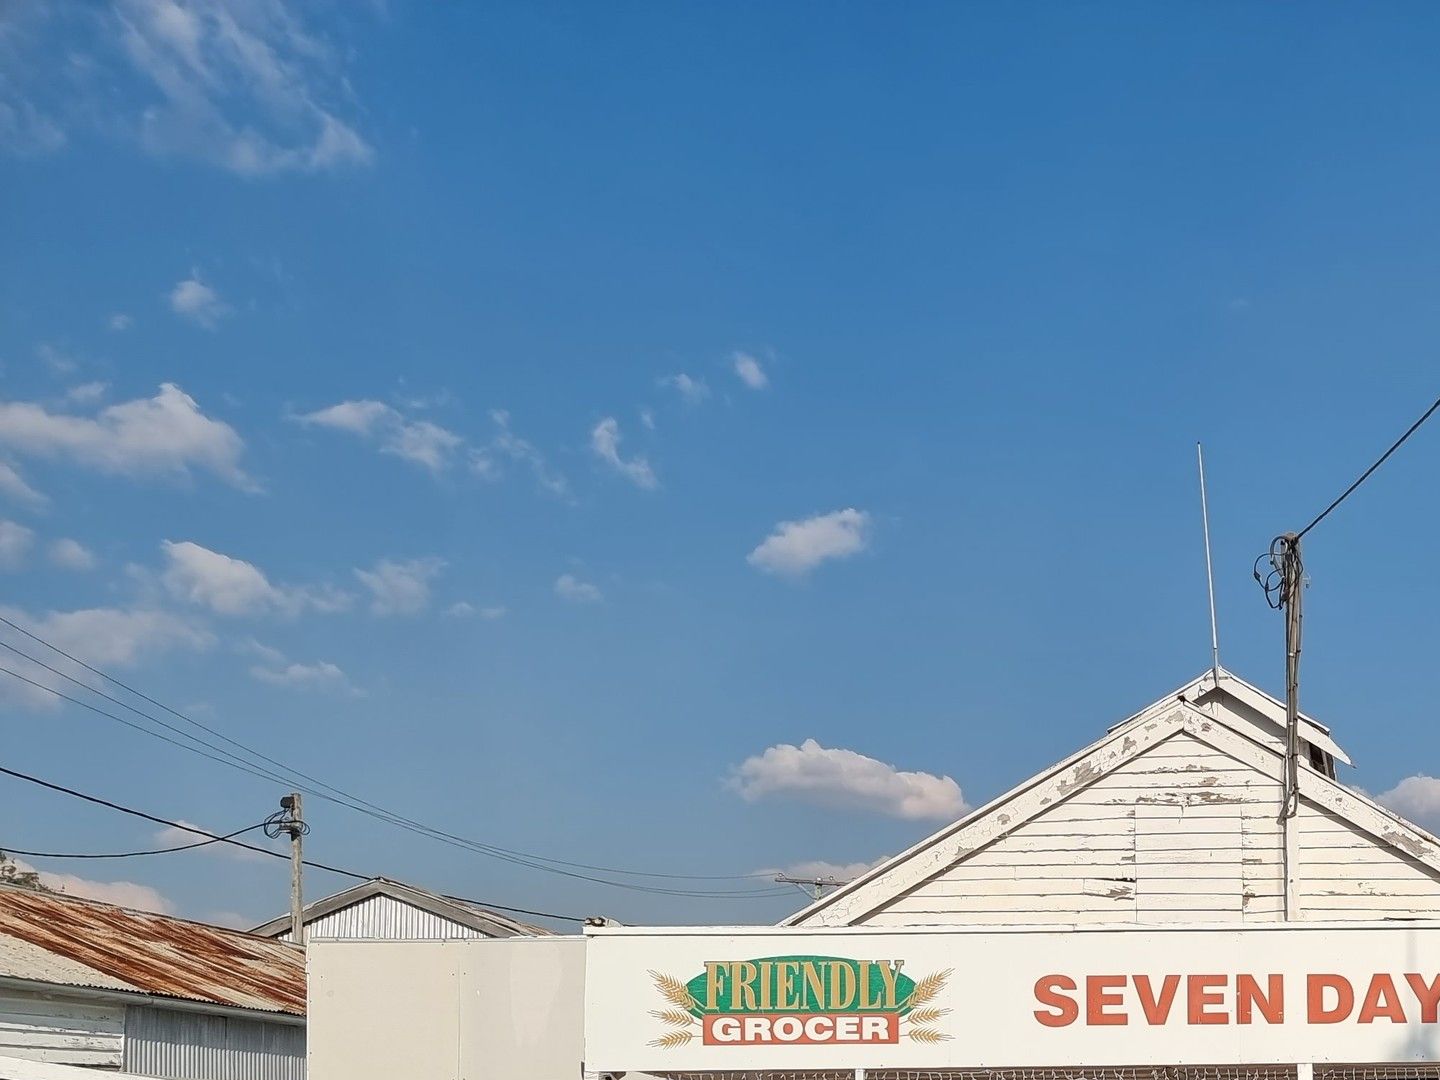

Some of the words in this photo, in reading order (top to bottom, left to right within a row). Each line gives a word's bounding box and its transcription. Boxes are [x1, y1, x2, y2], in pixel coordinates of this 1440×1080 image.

[704, 959, 905, 1011] FRIENDLY
[1033, 974, 1284, 1028] SEVEN
[711, 1016, 890, 1042] GROCER
